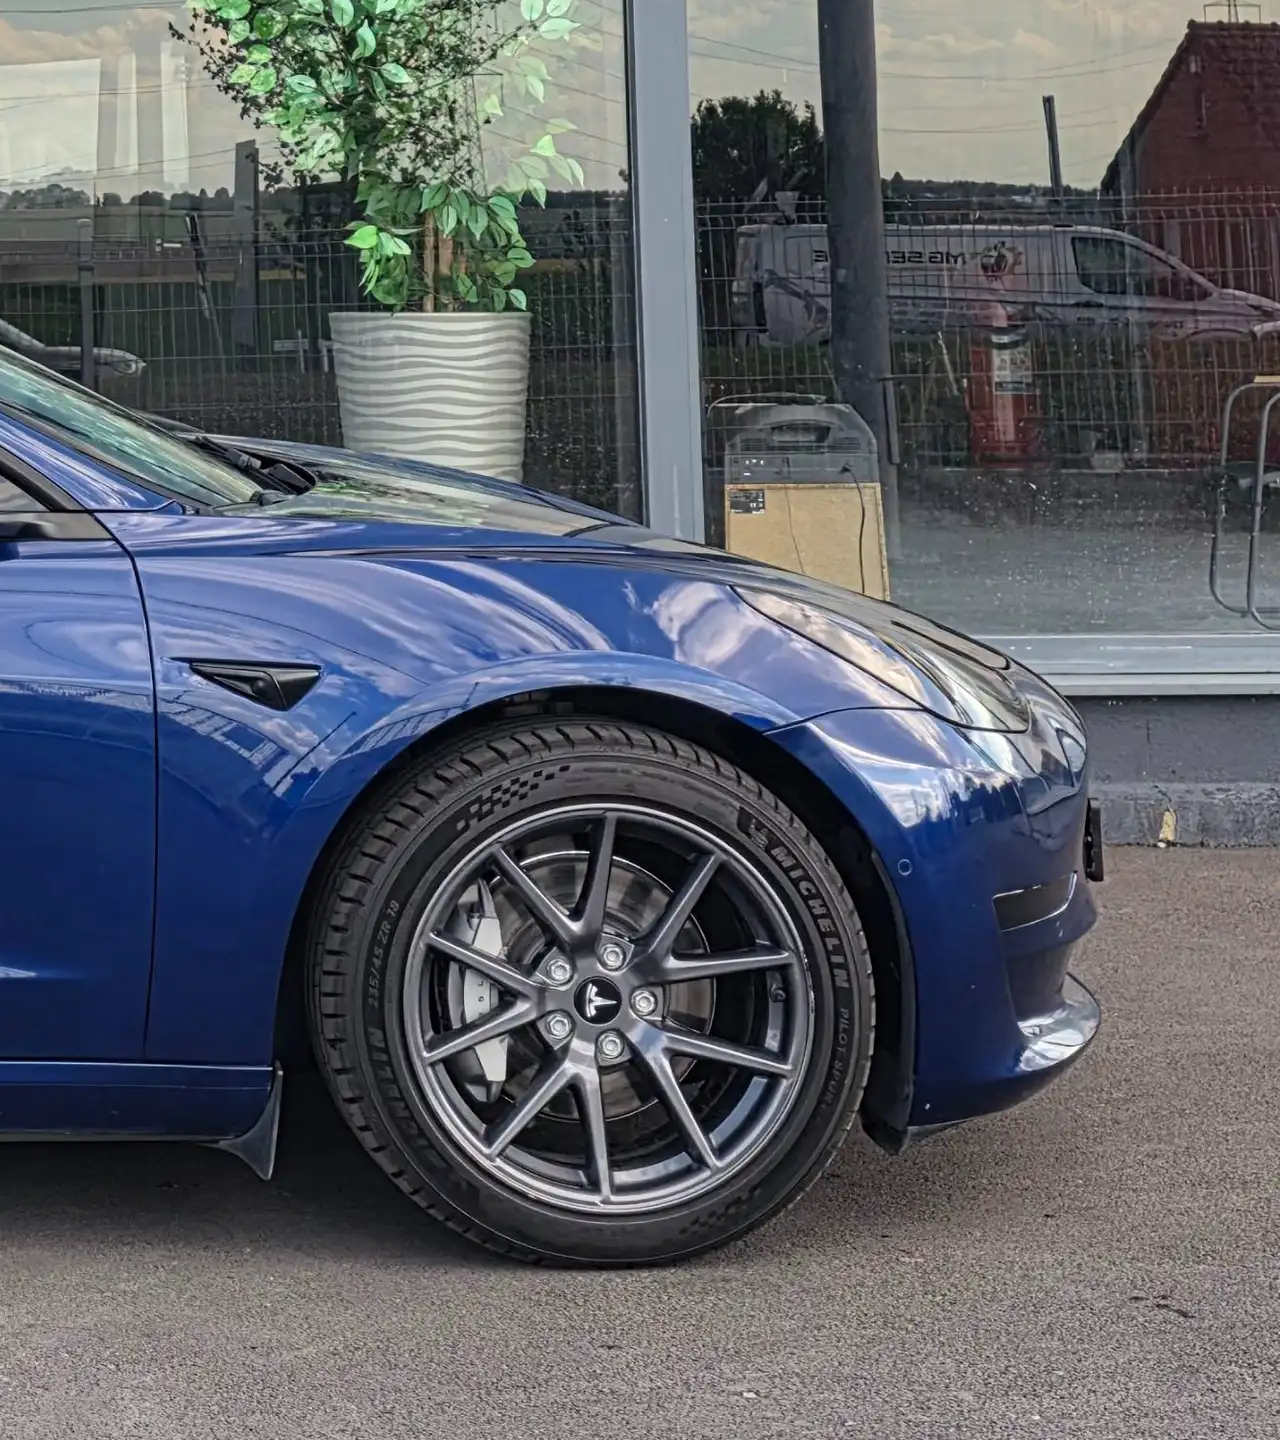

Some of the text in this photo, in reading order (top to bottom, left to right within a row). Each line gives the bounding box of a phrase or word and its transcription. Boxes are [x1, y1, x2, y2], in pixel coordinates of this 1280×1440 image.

[367, 946, 384, 1009] 235/45
[376, 920, 392, 945] ZR
[770, 844, 850, 989] MICHELIN
[835, 1006, 851, 1055] PILOT
